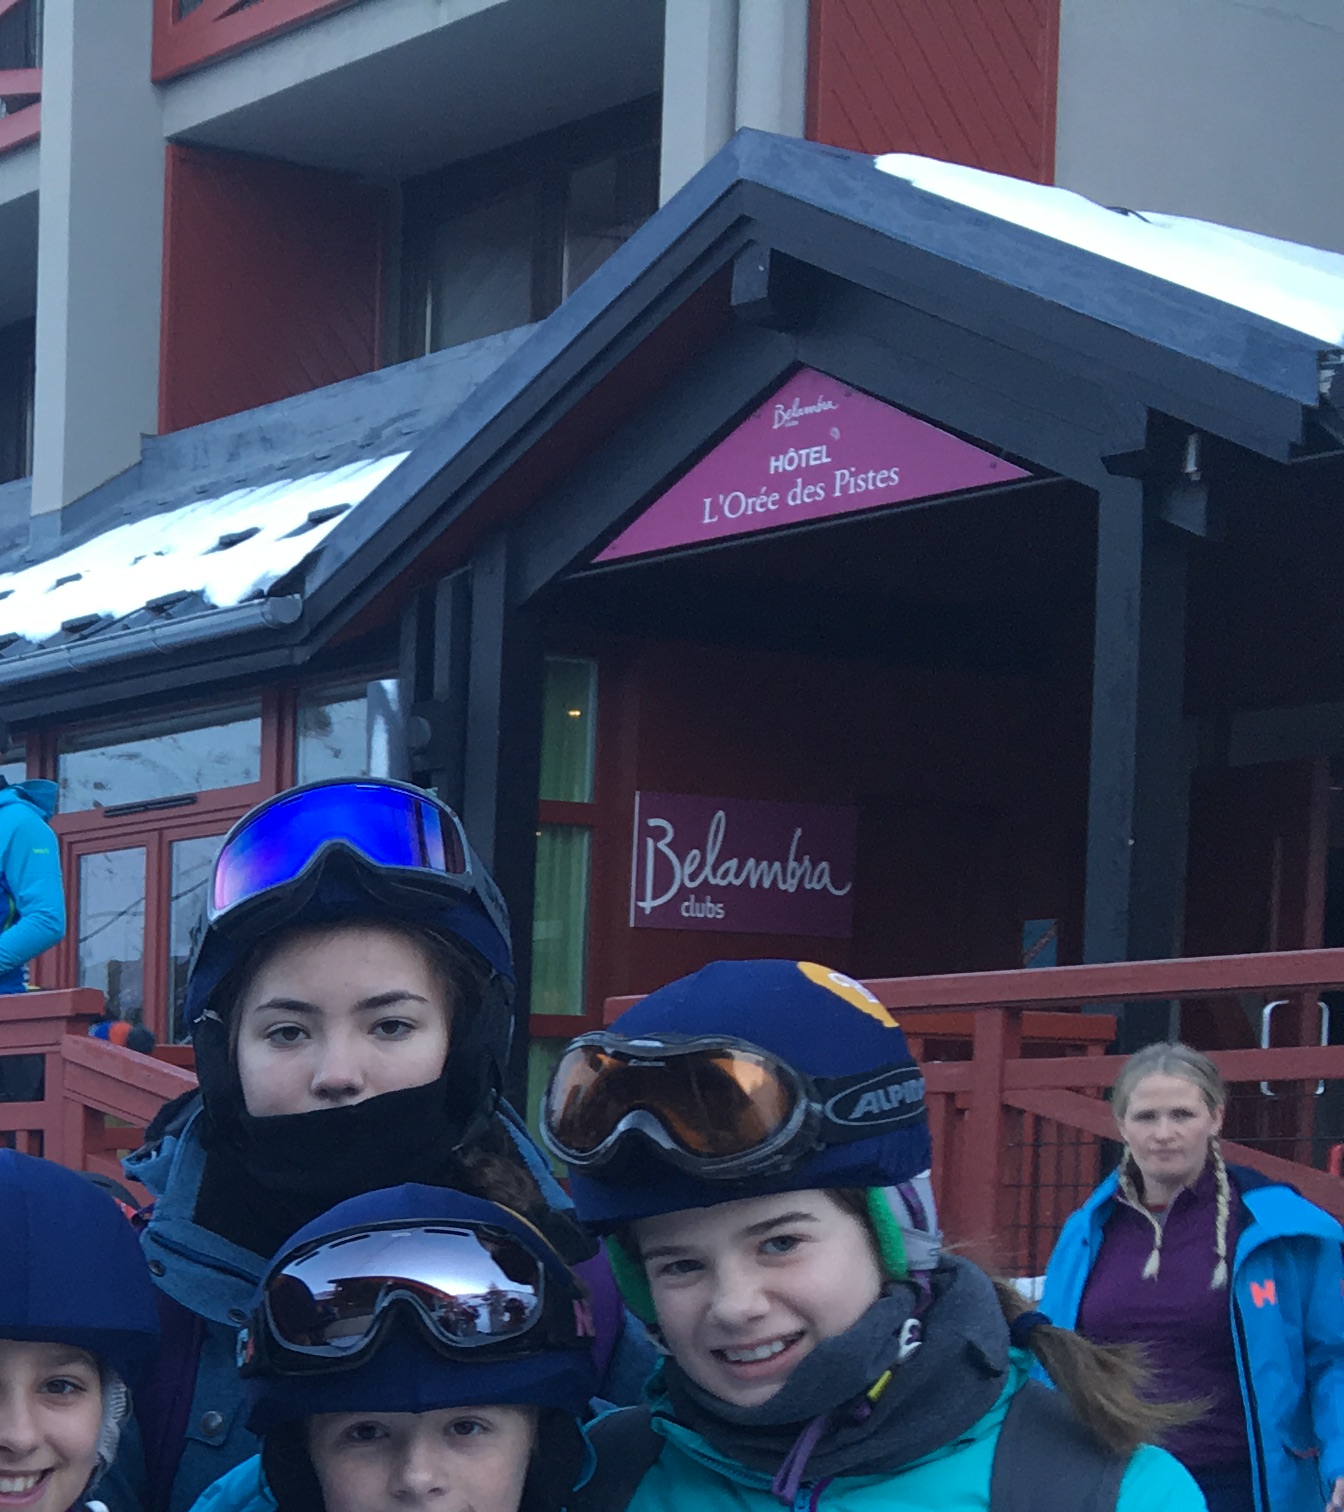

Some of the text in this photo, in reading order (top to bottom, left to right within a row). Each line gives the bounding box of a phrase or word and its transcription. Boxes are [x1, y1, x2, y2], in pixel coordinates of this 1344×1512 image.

[769, 444, 832, 474] HÔTEL
[702, 466, 900, 523] L'Orée des Pistes
[636, 809, 852, 915] Belambra
[680, 894, 725, 919] clubs
